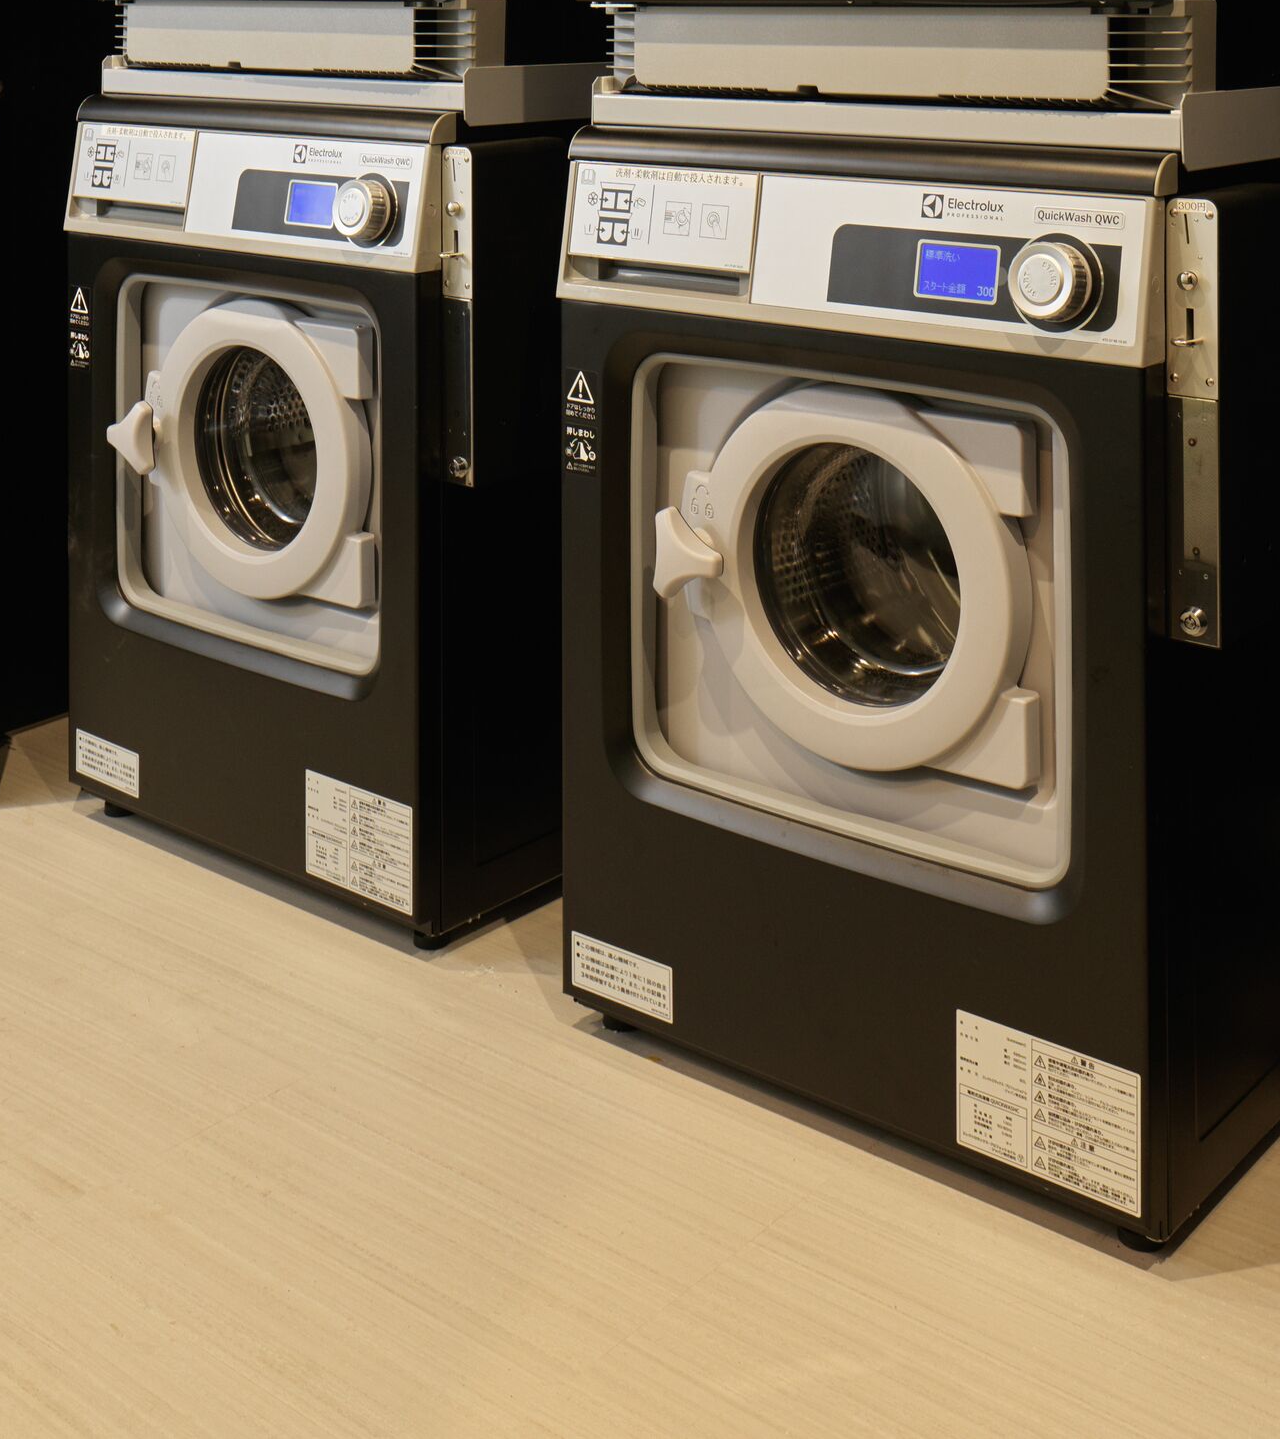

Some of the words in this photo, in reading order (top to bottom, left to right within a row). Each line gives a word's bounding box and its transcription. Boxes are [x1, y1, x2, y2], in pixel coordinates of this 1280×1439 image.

[309, 147, 343, 159] Electrolux
[362, 155, 395, 165] QuickWash
[395, 156, 411, 167] QWC
[947, 197, 1004, 214] Electrolux
[946, 212, 1004, 222] PROFESSIONAL
[1037, 209, 1093, 224] QuickWash
[1094, 213, 1120, 226] QWC
[976, 285, 994, 298] 300
